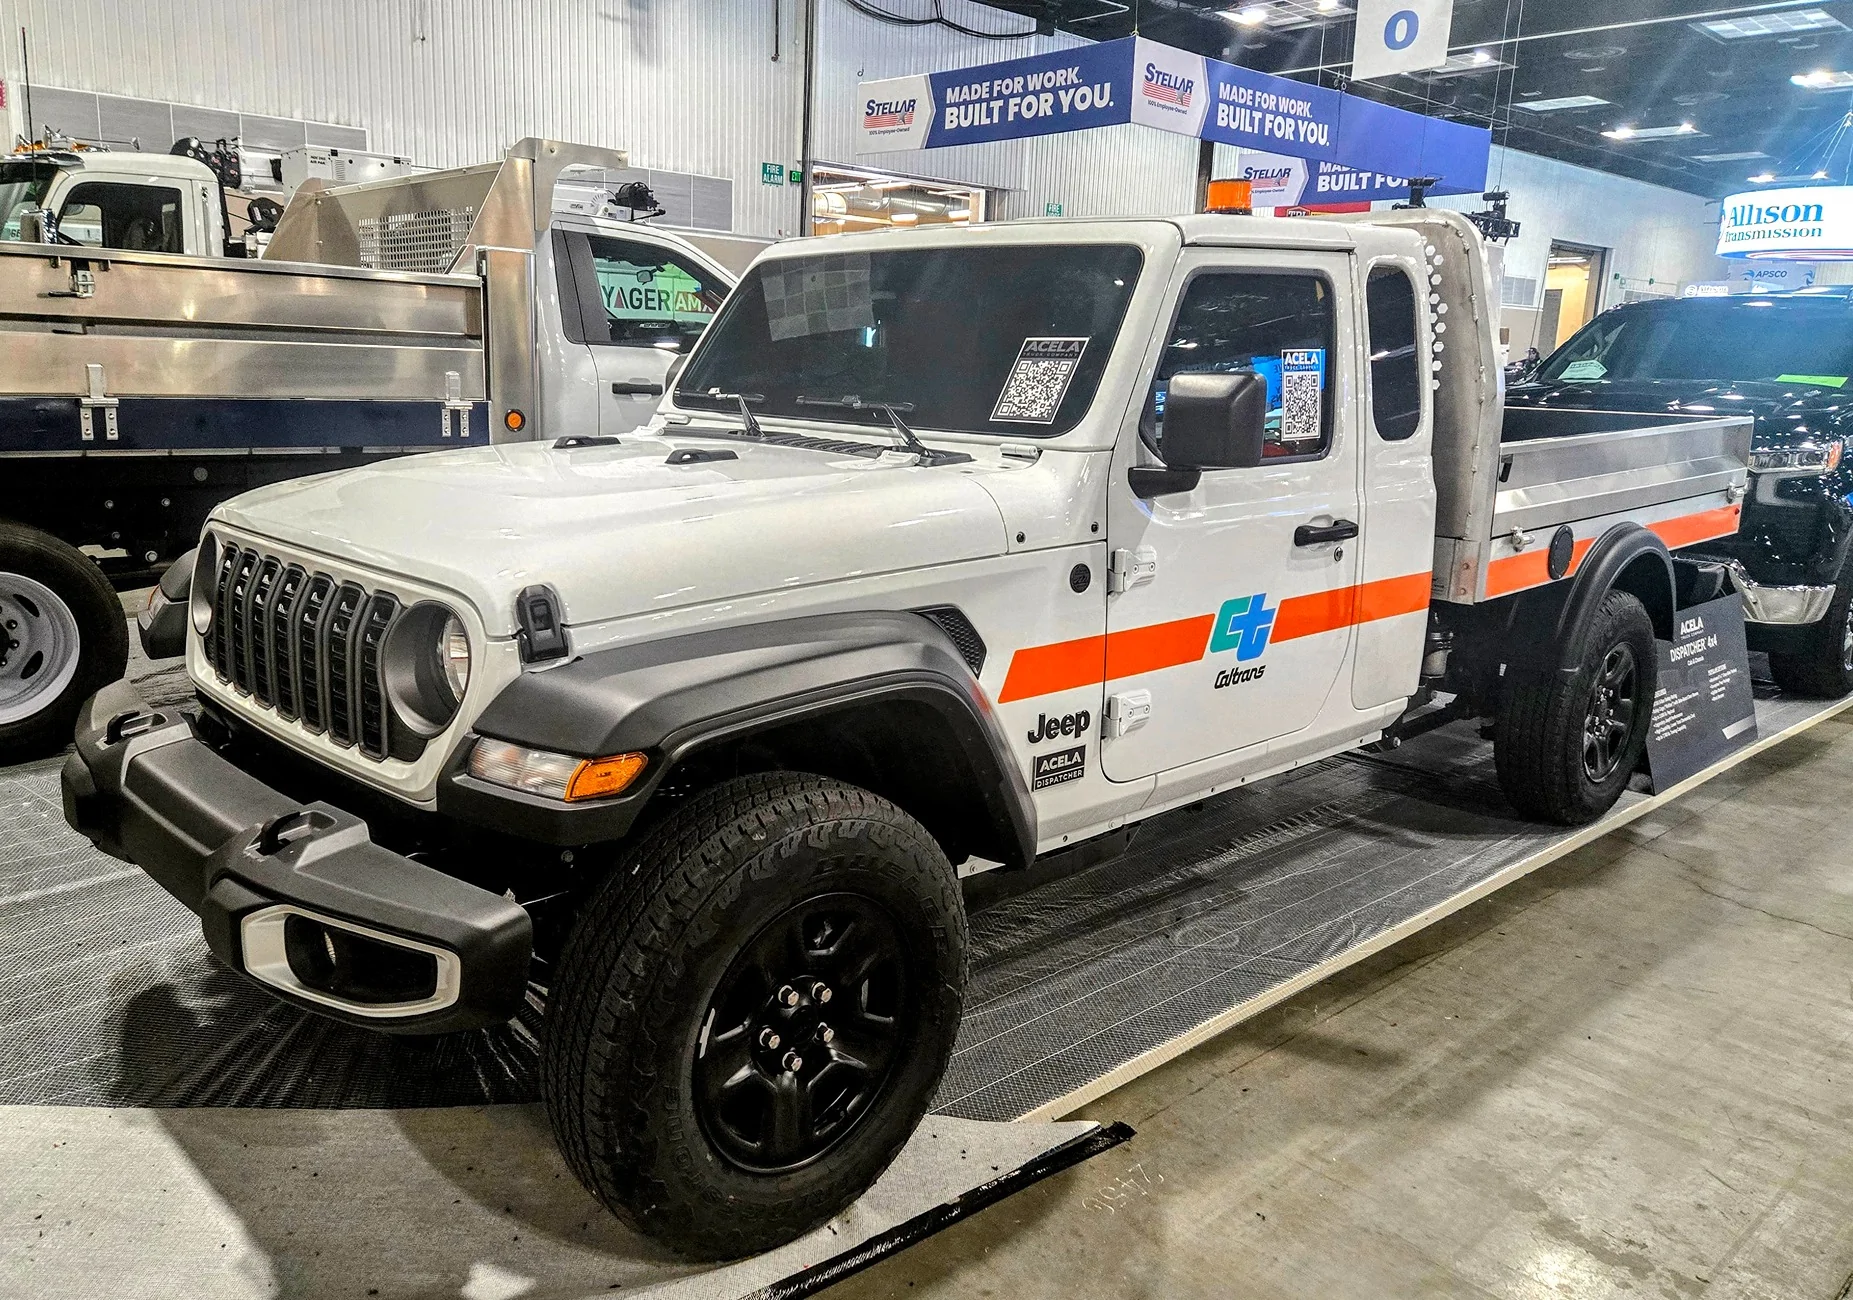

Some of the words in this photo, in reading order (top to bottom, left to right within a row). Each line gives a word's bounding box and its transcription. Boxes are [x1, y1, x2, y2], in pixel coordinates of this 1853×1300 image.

[946, 86, 990, 104] MADE
[993, 77, 1024, 97] FOR
[1026, 66, 1083, 91] WORK.
[1144, 62, 1195, 94] STELLAR
[865, 98, 917, 117] STELLAR
[945, 99, 1003, 129] BUILT
[1008, 93, 1054, 121] FOR
[1058, 83, 1115, 113] YOU.
[1219, 82, 1254, 107] MADE
[1255, 91, 1276, 110] FOR
[1278, 96, 1313, 118] WORK.
[1217, 102, 1264, 135] BUILT
[1264, 115, 1295, 140] FOR
[1297, 120, 1330, 147] YOU.
[763, 173, 783, 184] ALARM
[766, 164, 780, 175] FIRE
[1243, 167, 1292, 180] STELLAR
[1317, 172, 1372, 192] BUILT
[1726, 203, 1824, 228] Allison
[1725, 228, 1822, 242] Transmission
[1756, 270, 1788, 278] APSCO
[1024, 341, 1080, 353] ACELA
[1284, 352, 1319, 365] ACELA
[1680, 616, 1704, 635] ACELA
[1214, 665, 1266, 689] Caltrans
[1027, 709, 1091, 744] Jeep
[1039, 751, 1082, 773] ACELA
[1035, 769, 1083, 789] DISPATCHER
